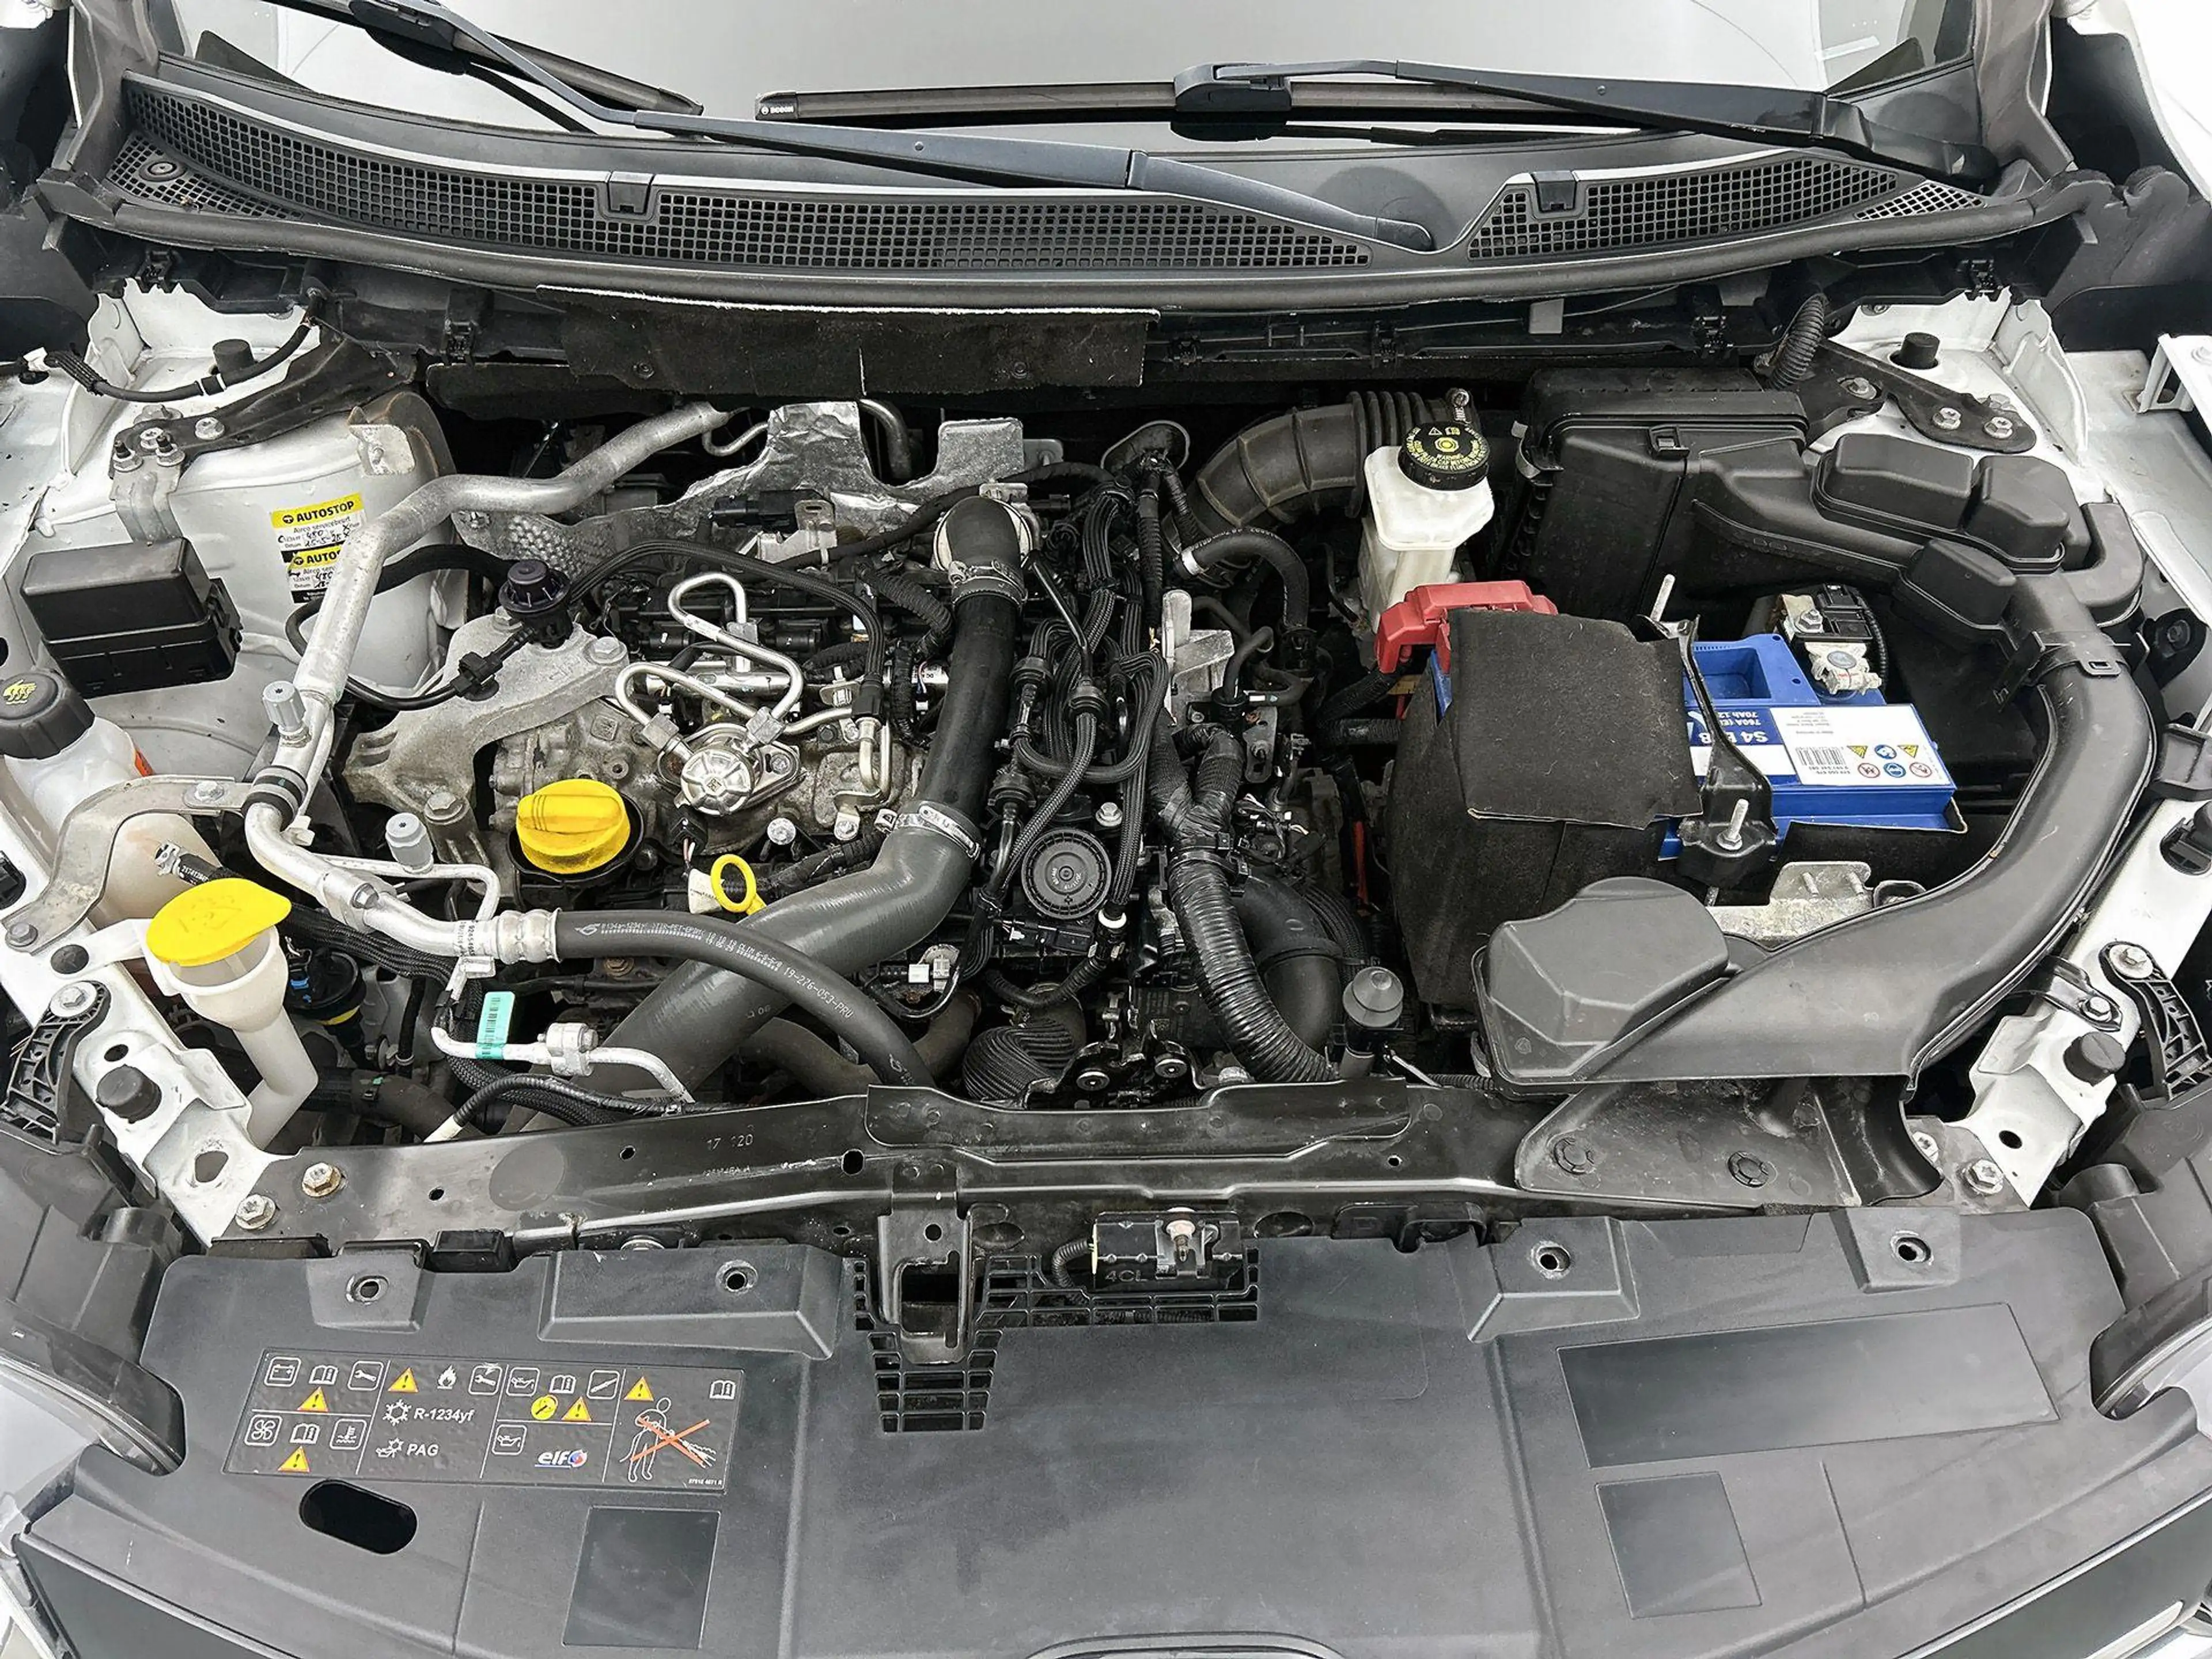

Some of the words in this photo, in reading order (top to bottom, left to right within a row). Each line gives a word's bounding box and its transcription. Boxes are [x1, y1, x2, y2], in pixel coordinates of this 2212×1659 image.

[297, 500, 355, 523] AUTOSTOP
[306, 550, 340, 565] AUTO
[1740, 730, 1769, 744] S4
[1105, 1269, 1149, 1282] 4CL
[414, 1408, 474, 1424] R-1234yf
[406, 1444, 440, 1457] PAG
[537, 1450, 571, 1465] elf
